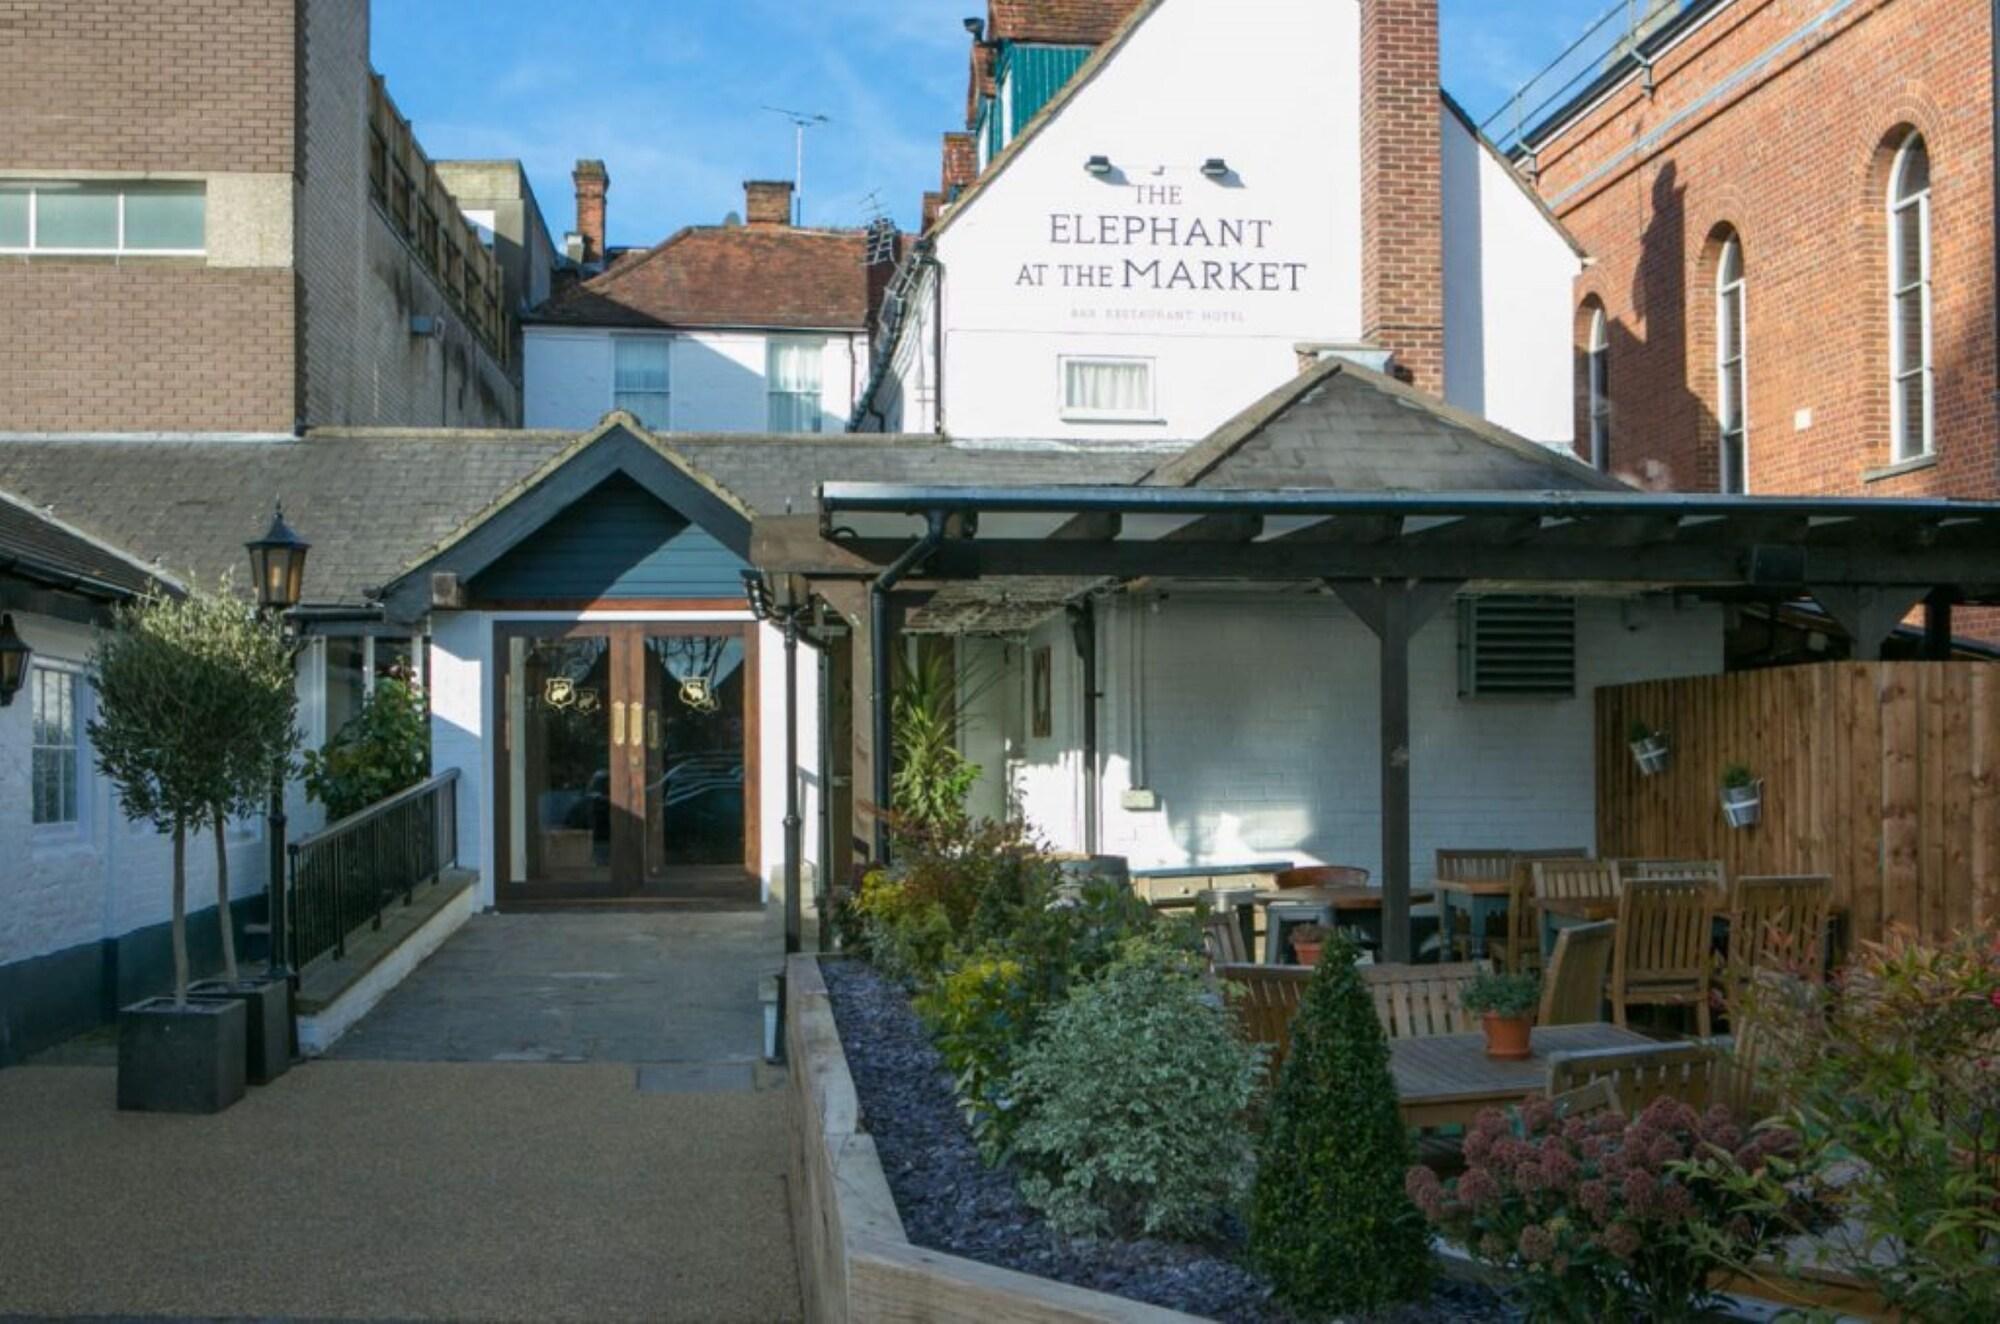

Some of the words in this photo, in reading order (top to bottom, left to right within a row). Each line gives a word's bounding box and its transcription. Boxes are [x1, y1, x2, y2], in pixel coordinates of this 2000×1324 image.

[1134, 184, 1182, 205] THE
[1050, 213, 1272, 248] ELEPHANT
[1015, 264, 1049, 287] AT
[1058, 264, 1113, 288] THE
[1121, 258, 1308, 292] MARKET
